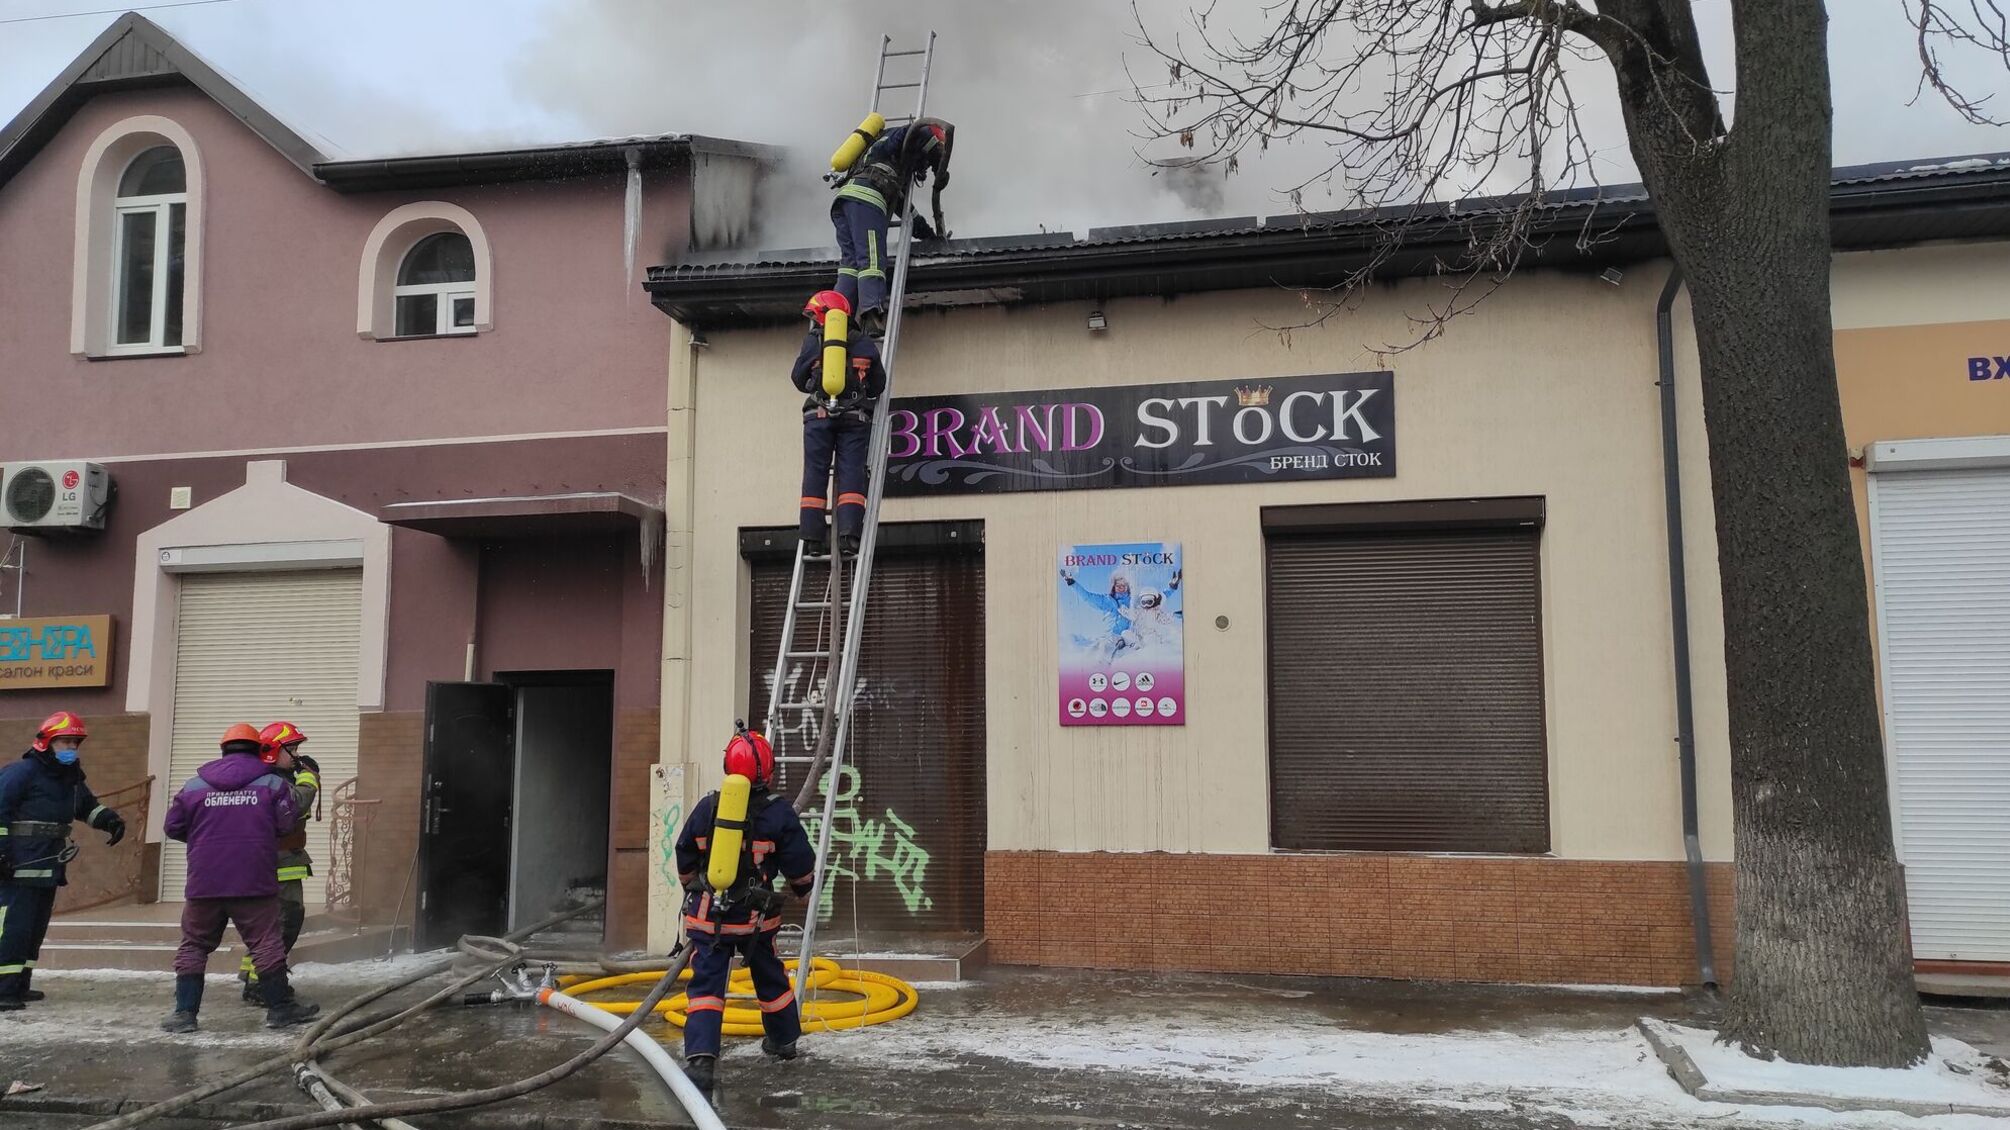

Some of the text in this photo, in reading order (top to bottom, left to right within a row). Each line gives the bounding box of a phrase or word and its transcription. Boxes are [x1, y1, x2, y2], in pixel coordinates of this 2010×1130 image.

[888, 402, 1105, 459] BRAND
[1270, 452, 1382, 470] БРЕНД СТОК
[62, 492, 76, 502] LG
[1065, 554, 1117, 567] BRAND
[48, 664, 93, 680] краси
[204, 795, 258, 807] ОБЛЕНЕРГО
